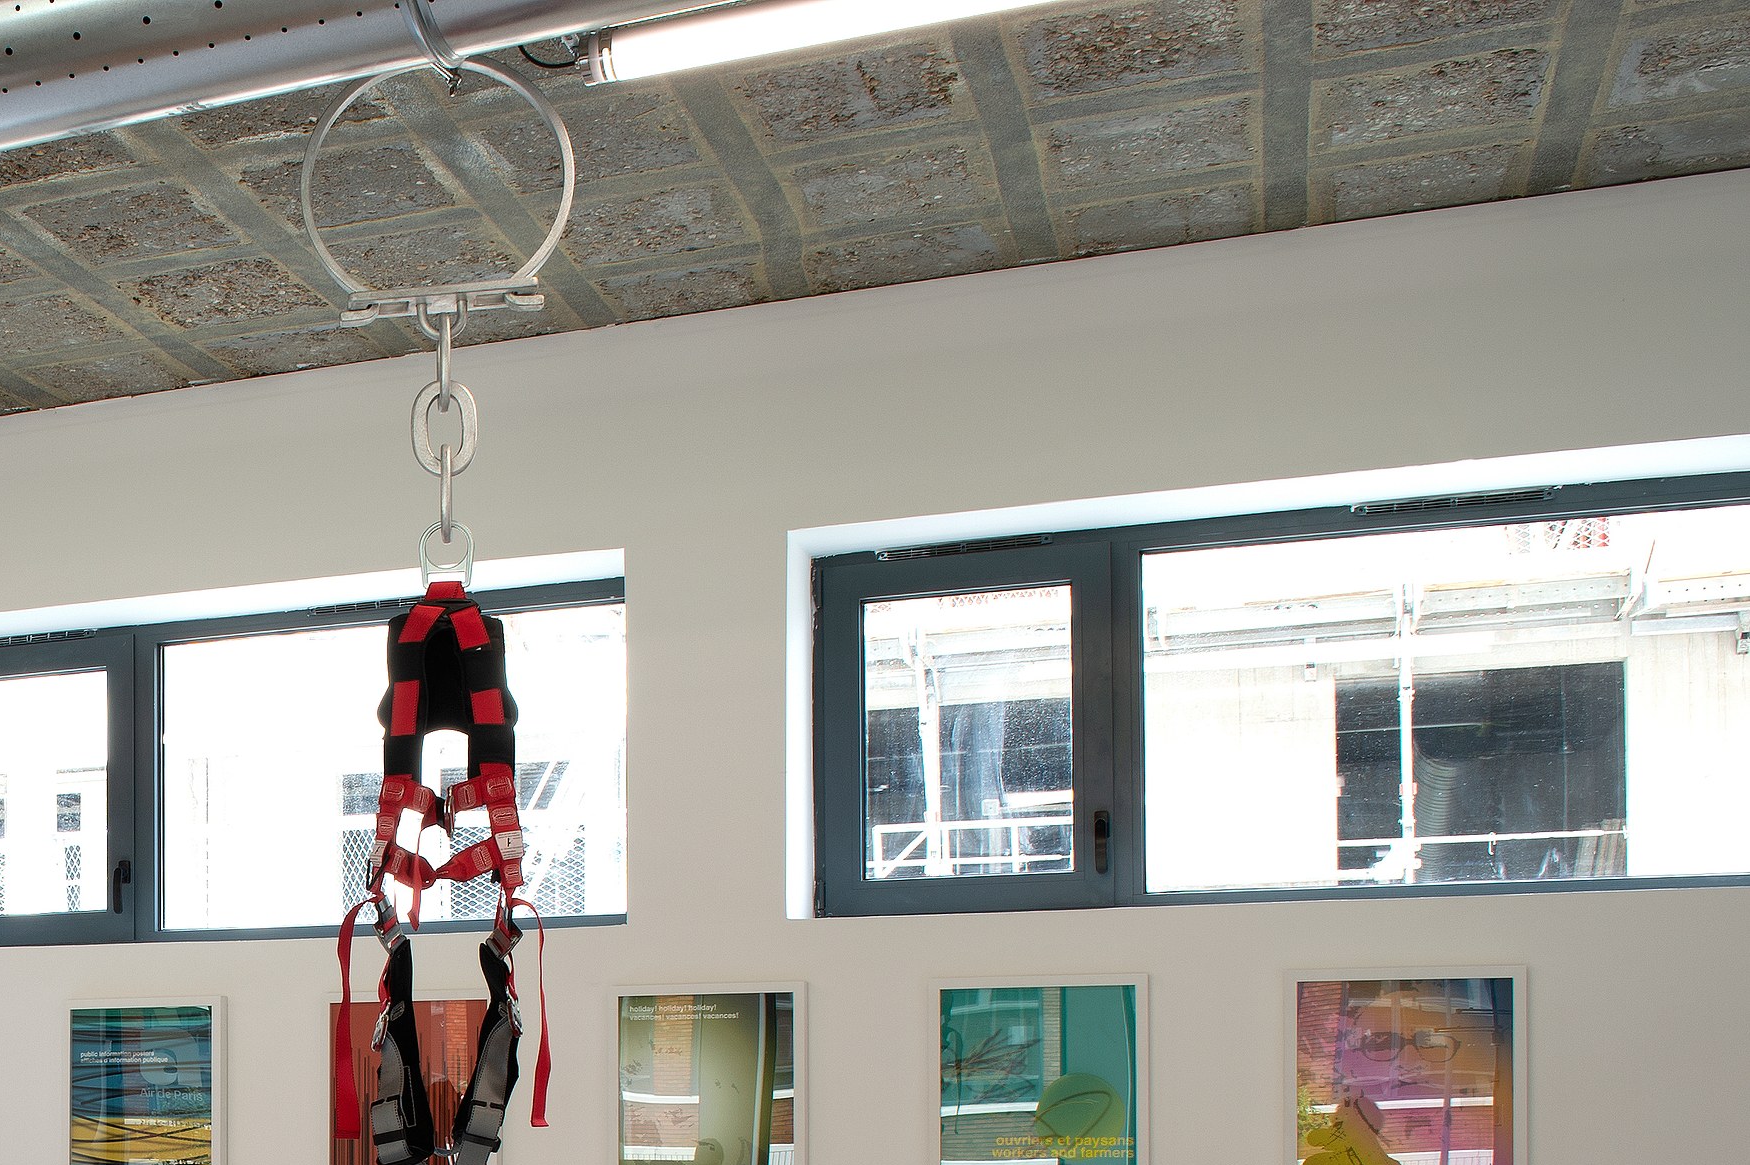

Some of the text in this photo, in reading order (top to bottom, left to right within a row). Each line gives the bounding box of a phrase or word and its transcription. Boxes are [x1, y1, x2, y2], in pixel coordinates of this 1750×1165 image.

[80, 1051, 98, 1059] public
[139, 1088, 203, 1101] Air de Paris
[995, 1135, 1135, 1148] ouvriers et paysans
[991, 1147, 1135, 1158] workers and farmers
